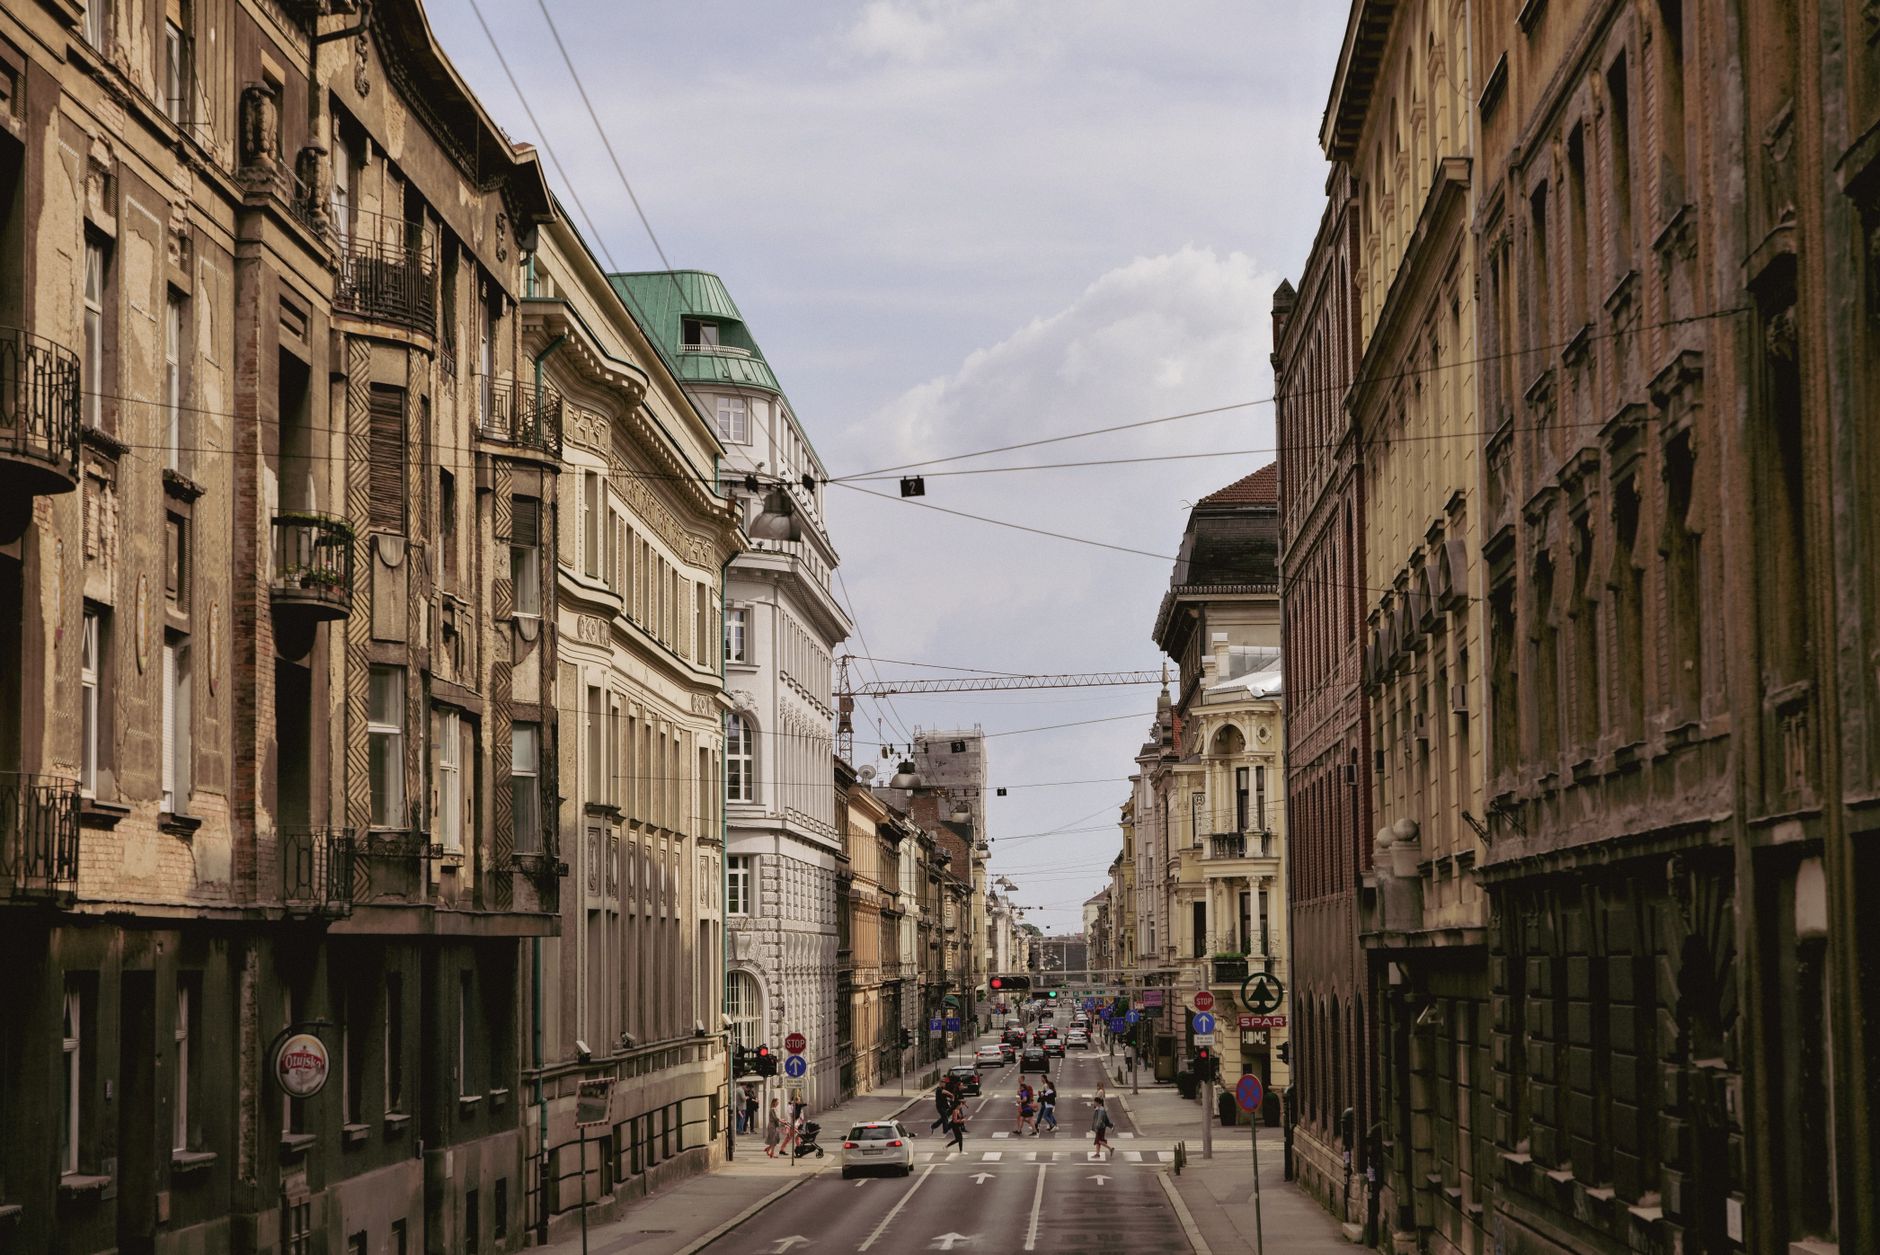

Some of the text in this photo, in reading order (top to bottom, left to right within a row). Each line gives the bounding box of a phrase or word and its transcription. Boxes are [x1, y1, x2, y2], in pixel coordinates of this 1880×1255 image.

[909, 481, 916, 495] 2
[955, 743, 961, 752] 3
[1196, 997, 1212, 1006] STOP
[1240, 1017, 1284, 1027] SPAR
[1242, 1031, 1267, 1045] HOME
[786, 1039, 805, 1049] STOP
